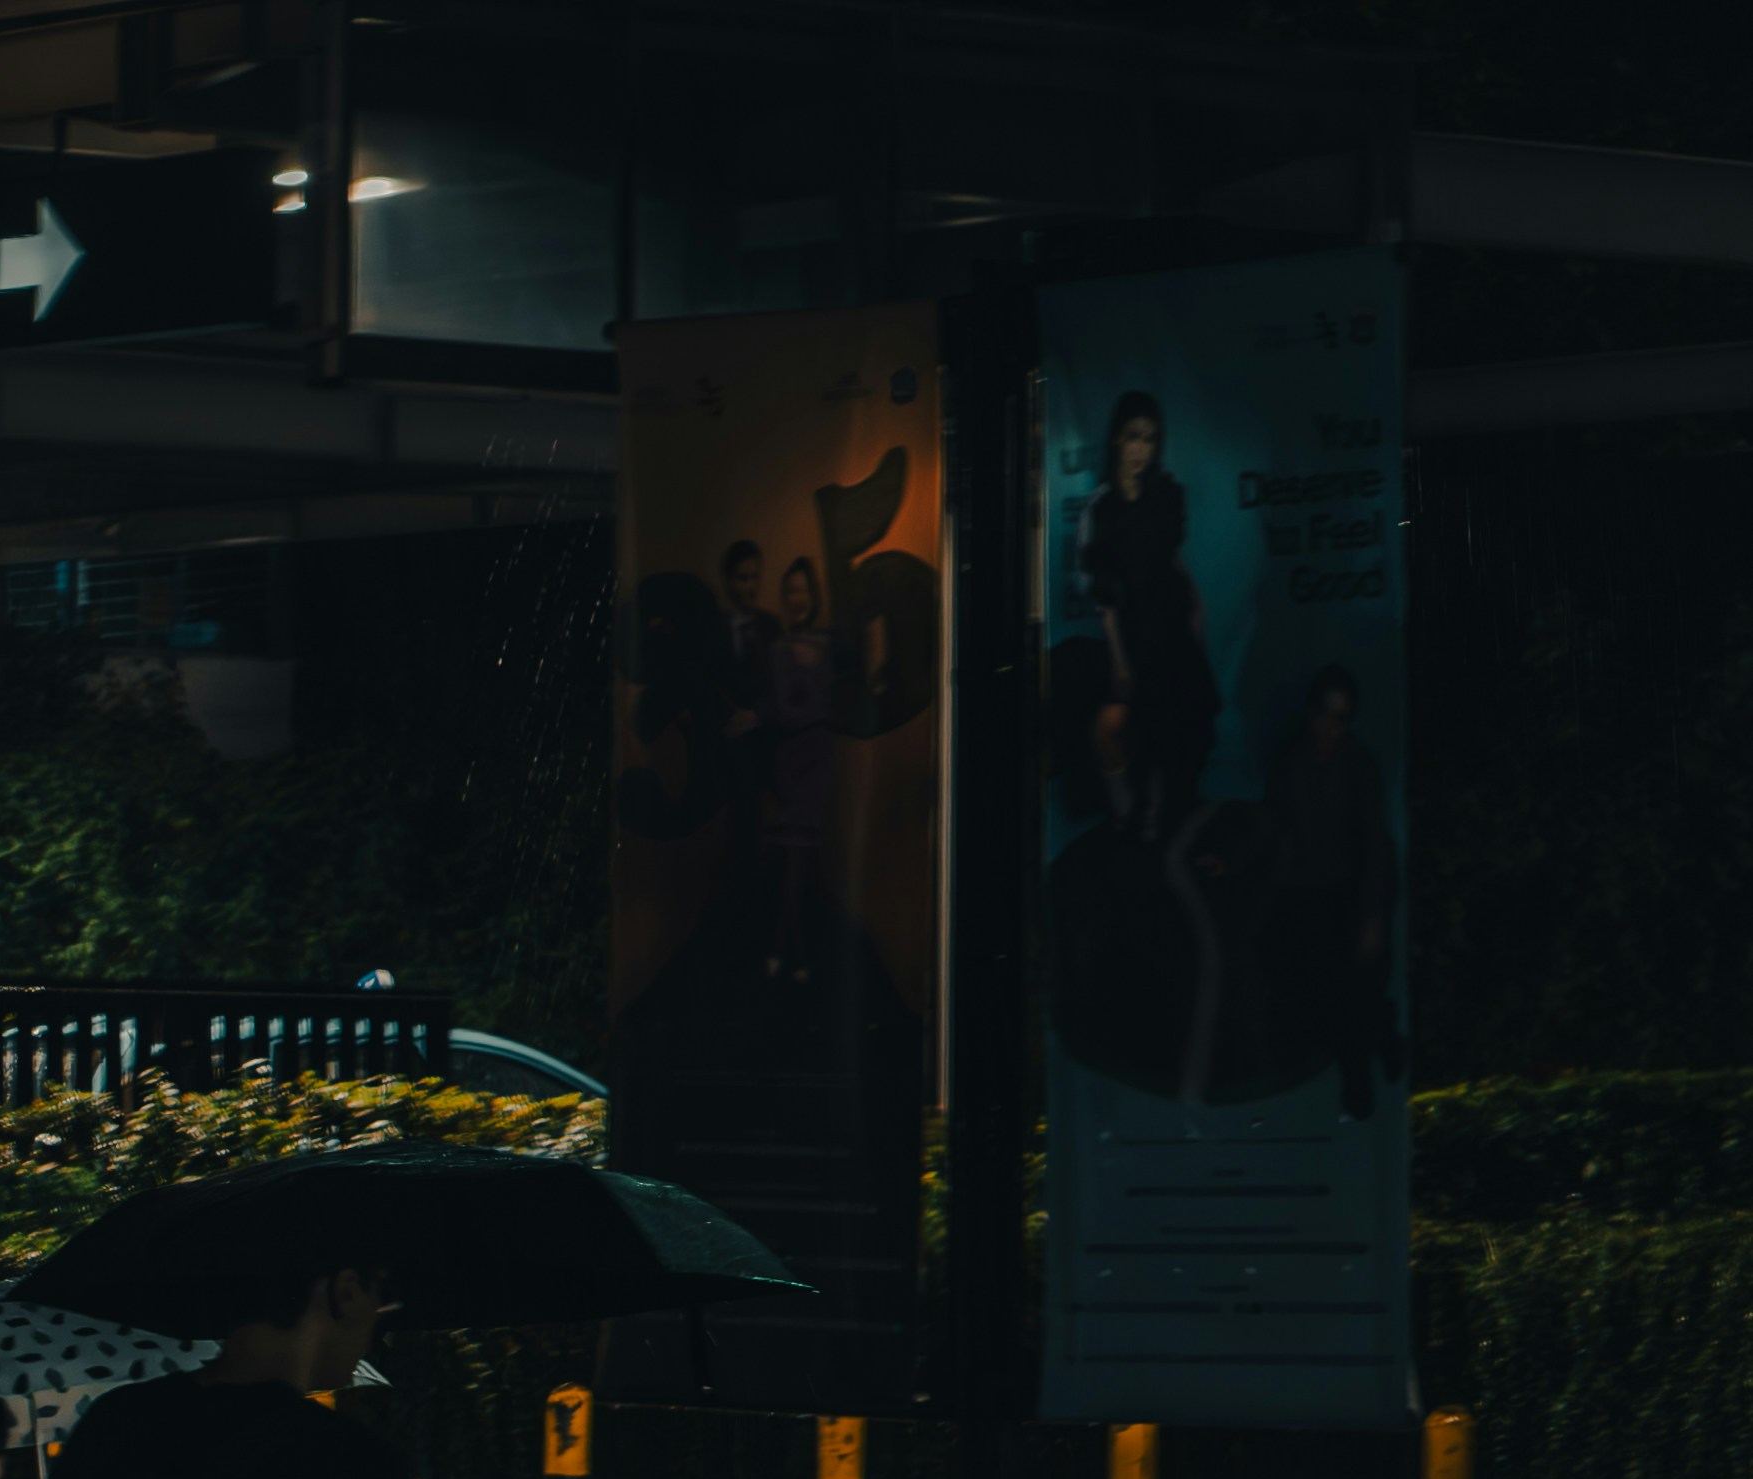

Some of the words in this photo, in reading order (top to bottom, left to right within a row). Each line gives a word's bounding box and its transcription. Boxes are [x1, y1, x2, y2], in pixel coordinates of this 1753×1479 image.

[1312, 411, 1383, 449] You
[1238, 467, 1385, 510] Deserve
[1308, 510, 1385, 552] Feel
[1289, 563, 1385, 605] Good
